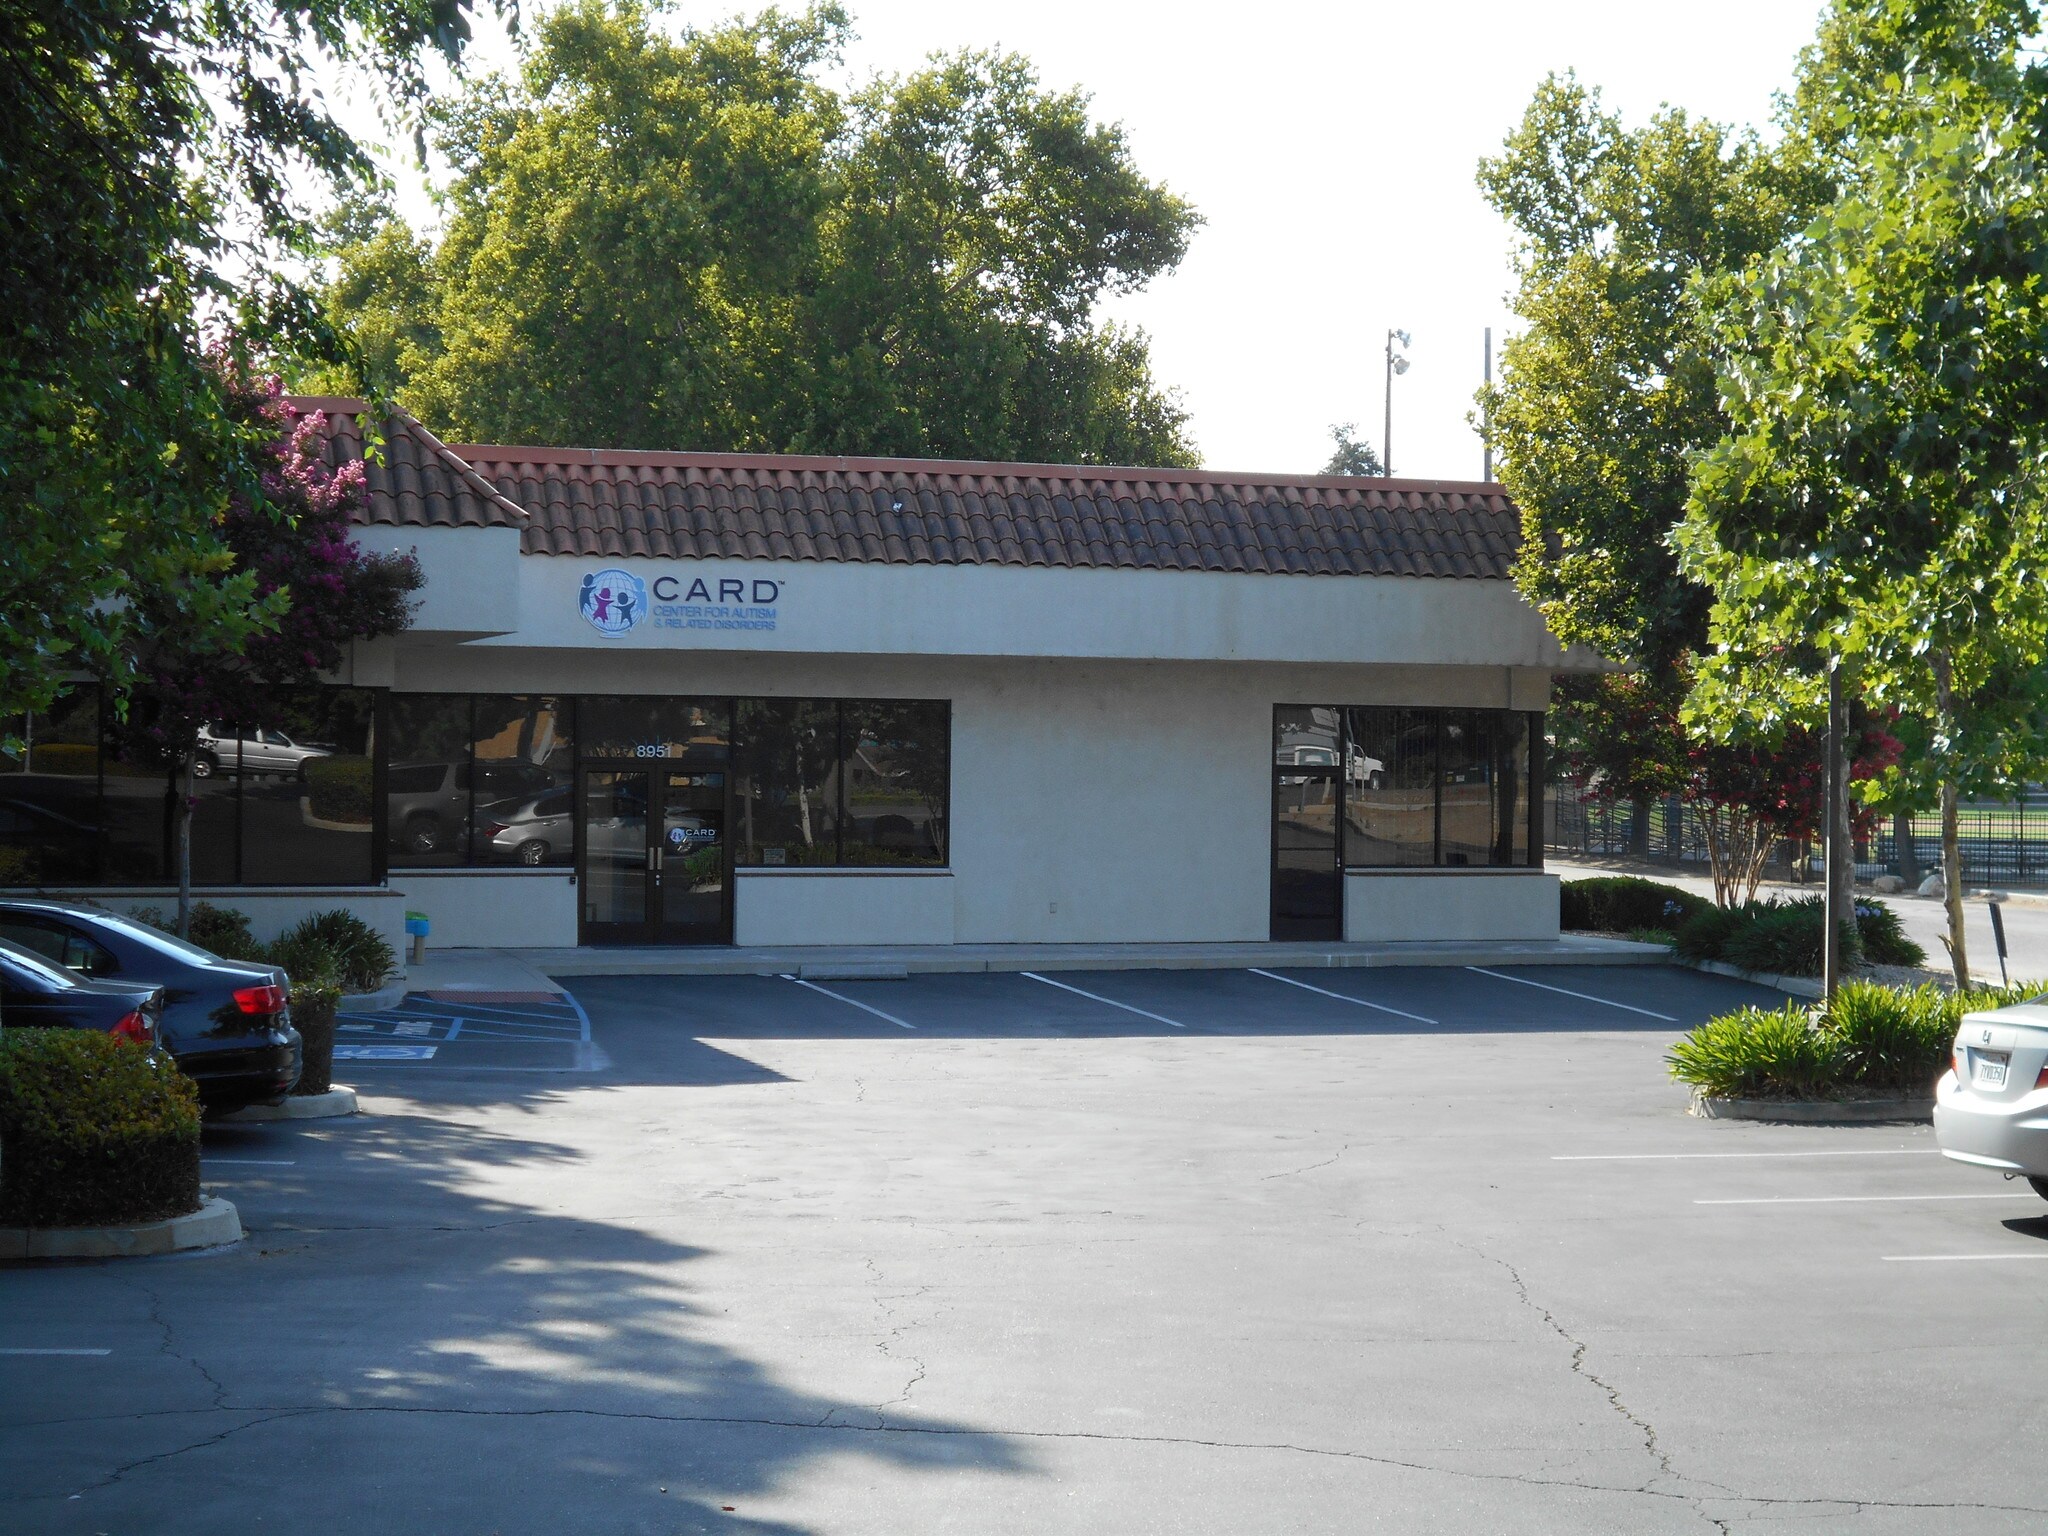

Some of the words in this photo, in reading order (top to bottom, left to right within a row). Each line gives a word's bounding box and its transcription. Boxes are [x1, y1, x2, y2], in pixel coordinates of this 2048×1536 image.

[653, 576, 779, 604] CARD
[653, 605, 702, 617] CENTER
[704, 606, 729, 618] FOR
[731, 607, 777, 619] AUTISM
[654, 618, 662, 629] &
[664, 618, 712, 629] RELATED
[714, 619, 777, 631] DISORDERS
[636, 745, 671, 758] 8951
[685, 828, 716, 836] CARD
